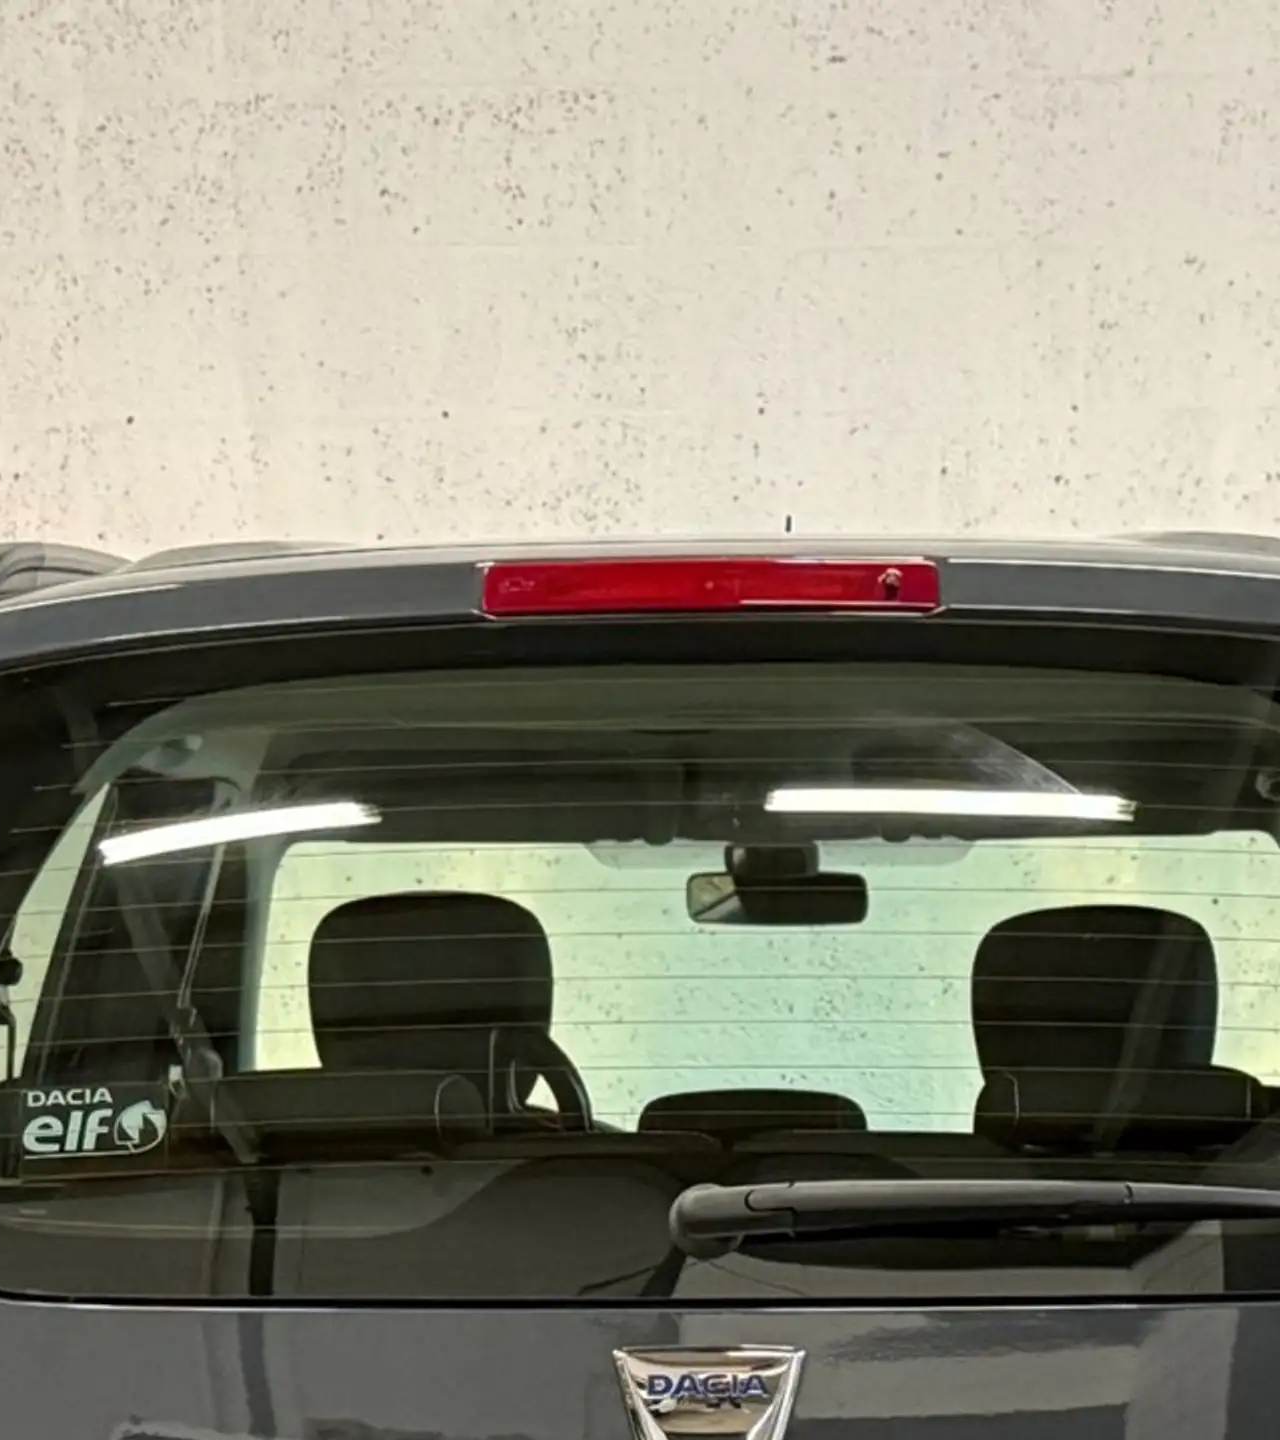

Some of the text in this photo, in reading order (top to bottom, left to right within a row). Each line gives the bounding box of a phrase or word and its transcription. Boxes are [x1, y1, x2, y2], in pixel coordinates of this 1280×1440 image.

[27, 1088, 112, 1107] DACIA
[22, 1108, 113, 1152] elf
[647, 1374, 769, 1397] DACIA
